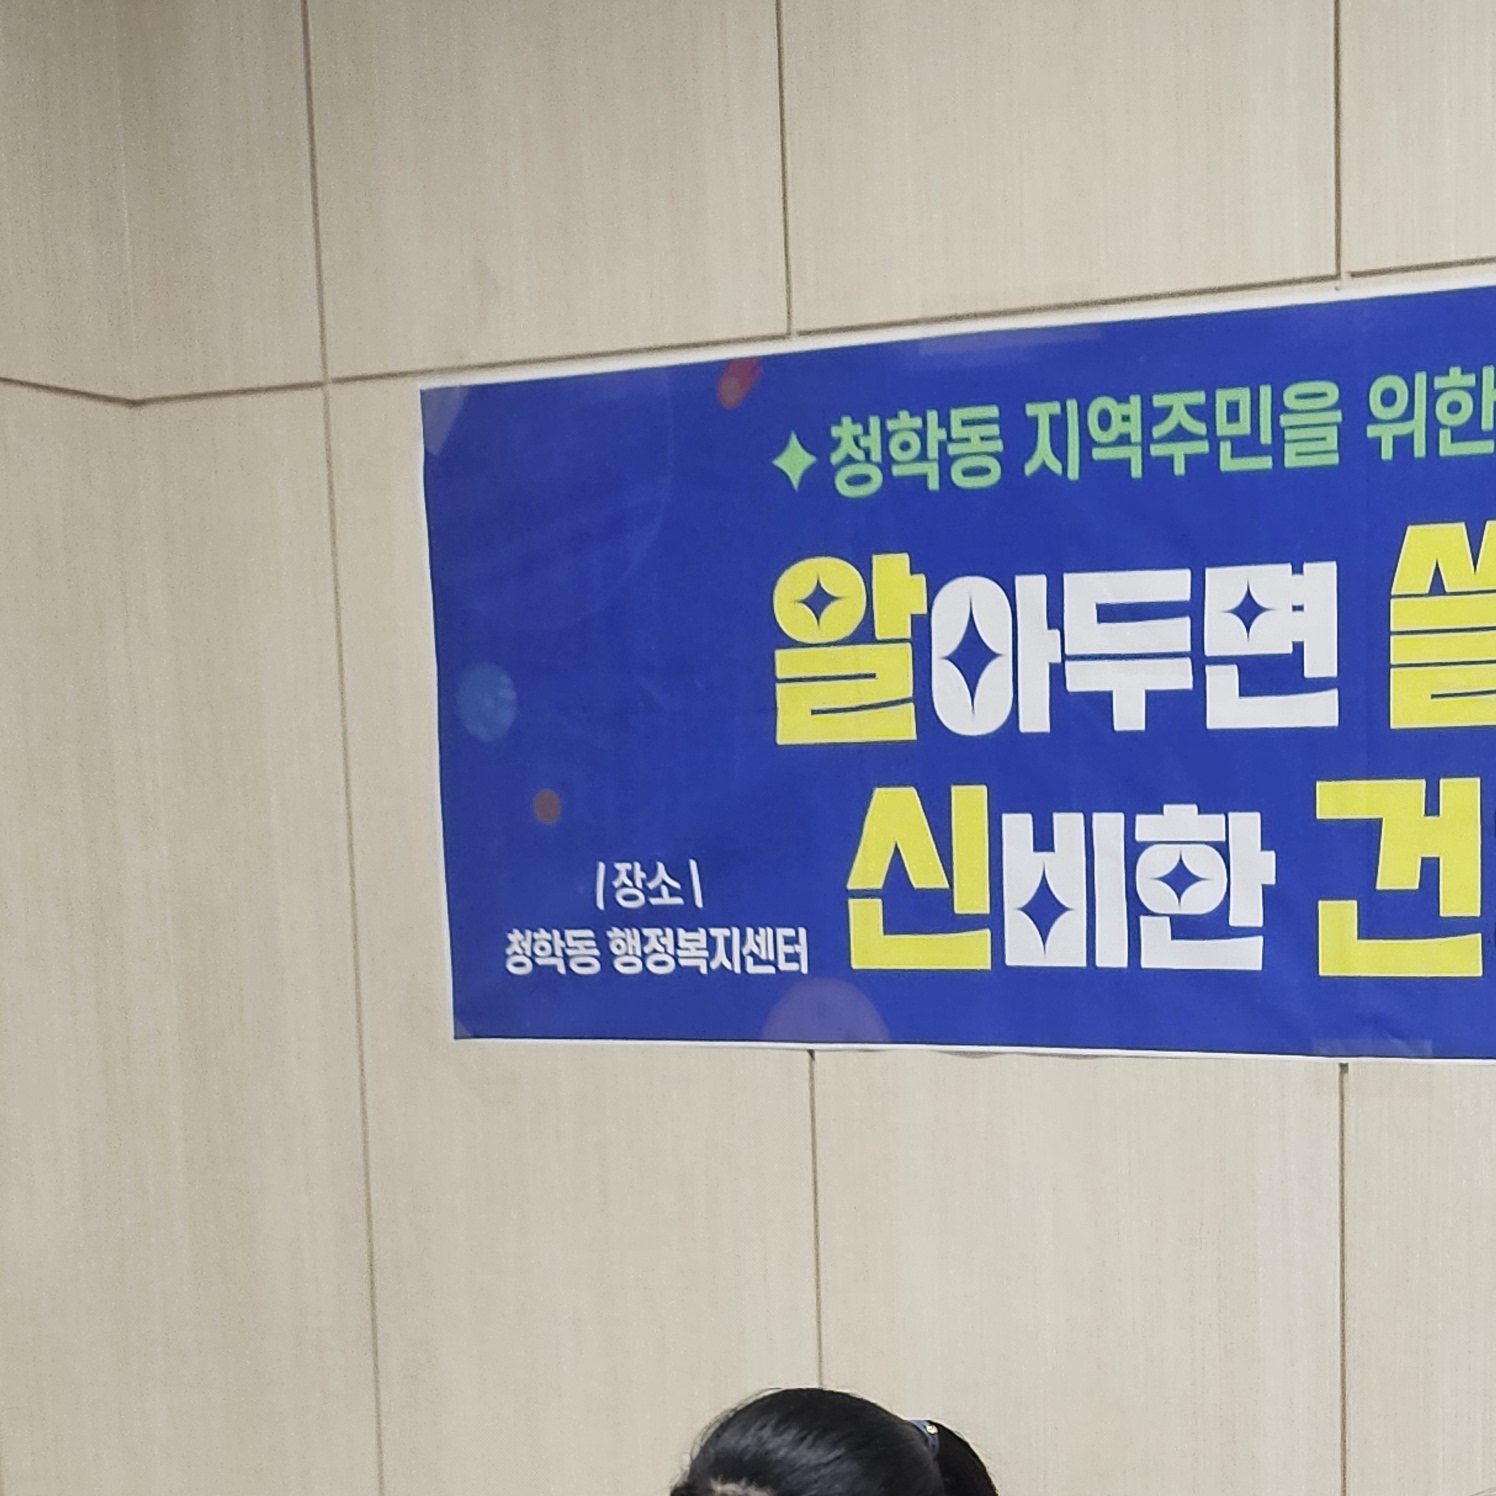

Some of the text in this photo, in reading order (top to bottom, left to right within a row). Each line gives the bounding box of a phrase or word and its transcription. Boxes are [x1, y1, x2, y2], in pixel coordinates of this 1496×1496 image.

[830, 403, 1004, 498] 청학동
[1023, 380, 1343, 481] 지역주민을
[772, 551, 1340, 746] 알아두면
[505, 926, 809, 976] 청학동 행정복지센터
[845, 783, 1277, 972] 신비한
